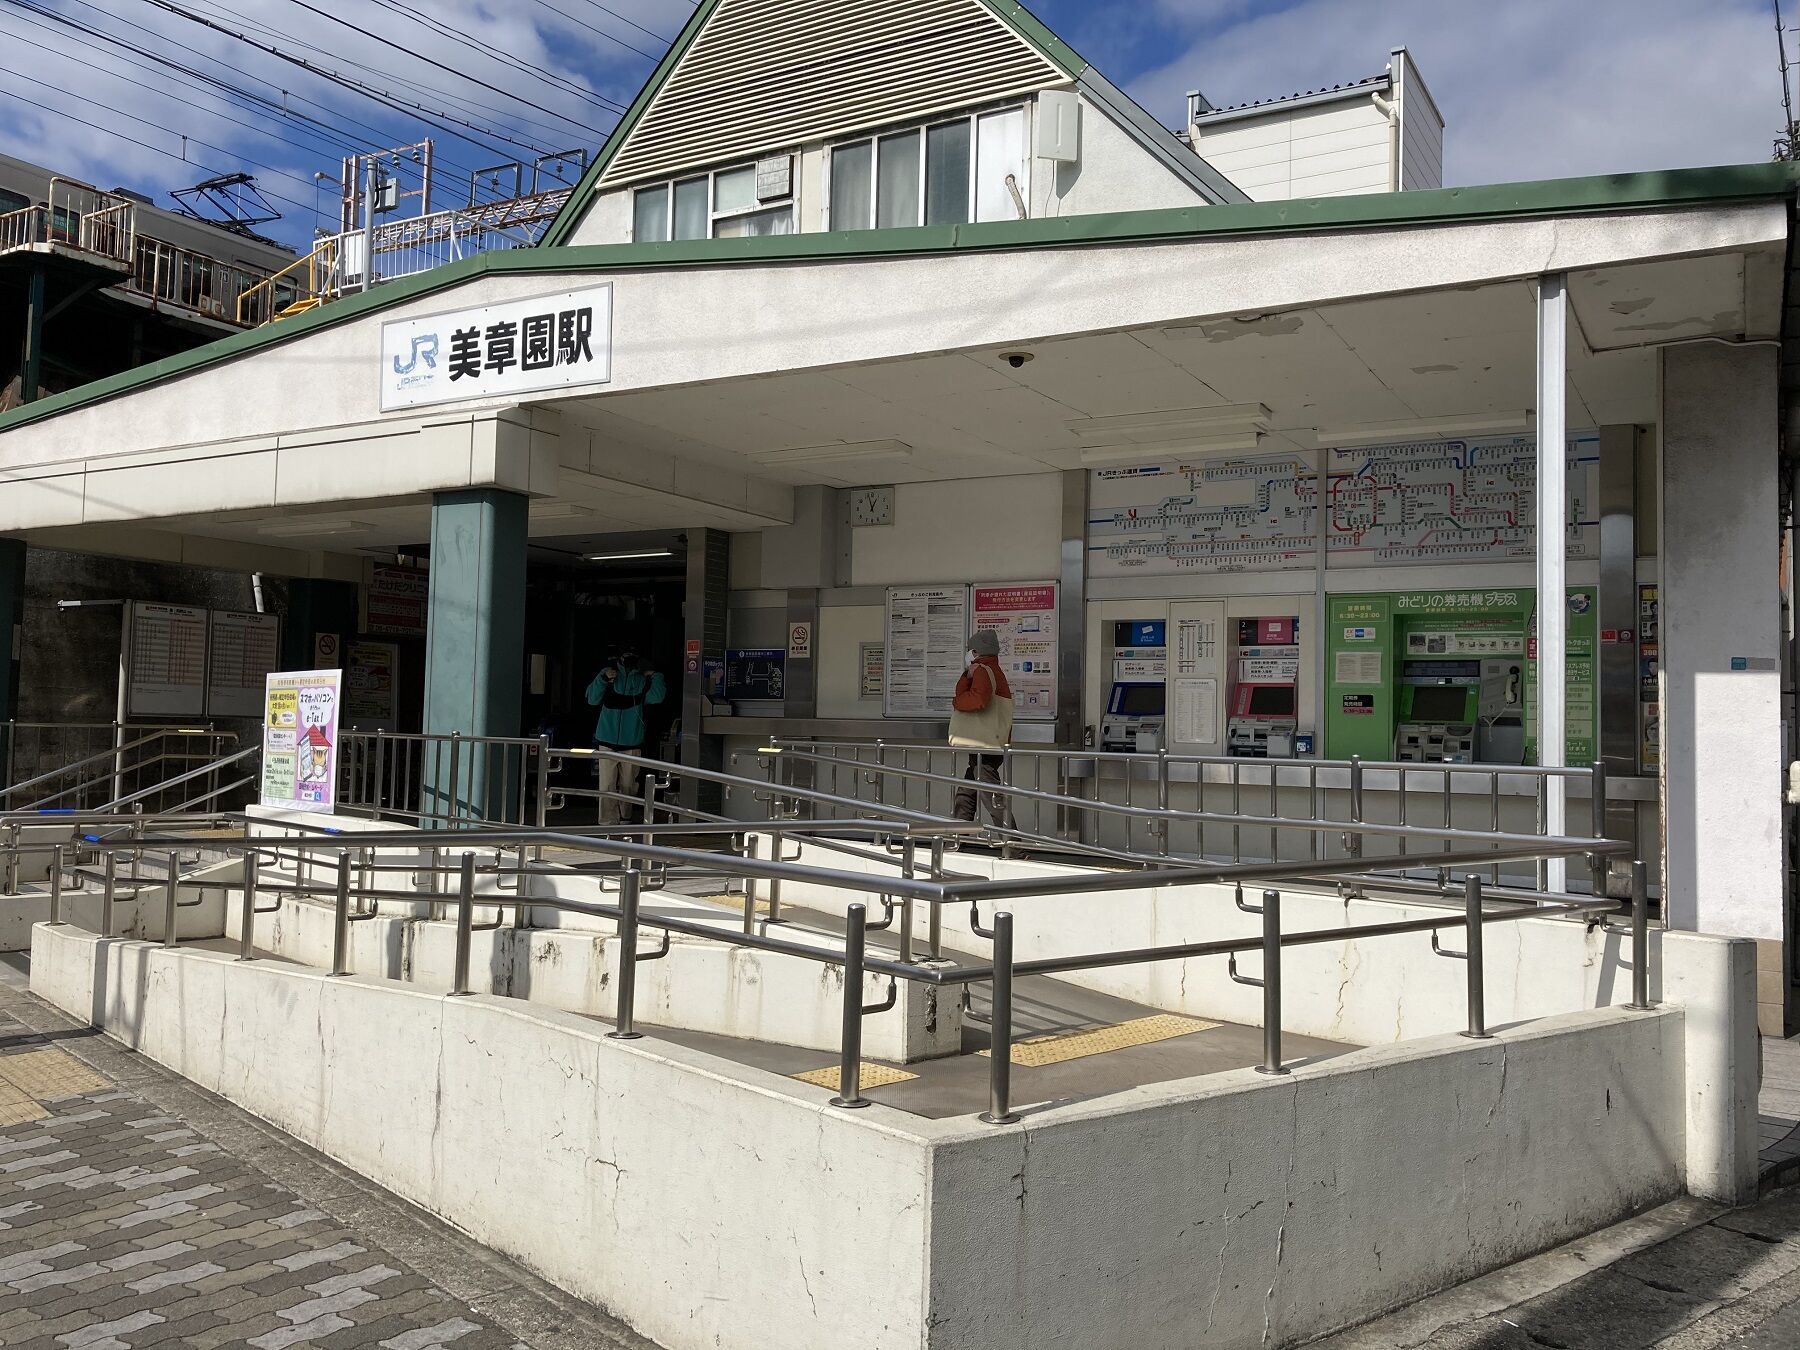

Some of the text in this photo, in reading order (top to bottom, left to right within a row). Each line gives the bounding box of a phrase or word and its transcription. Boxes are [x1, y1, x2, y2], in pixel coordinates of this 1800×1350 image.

[394, 333, 438, 374] JR
[449, 307, 593, 381] 美章園駅
